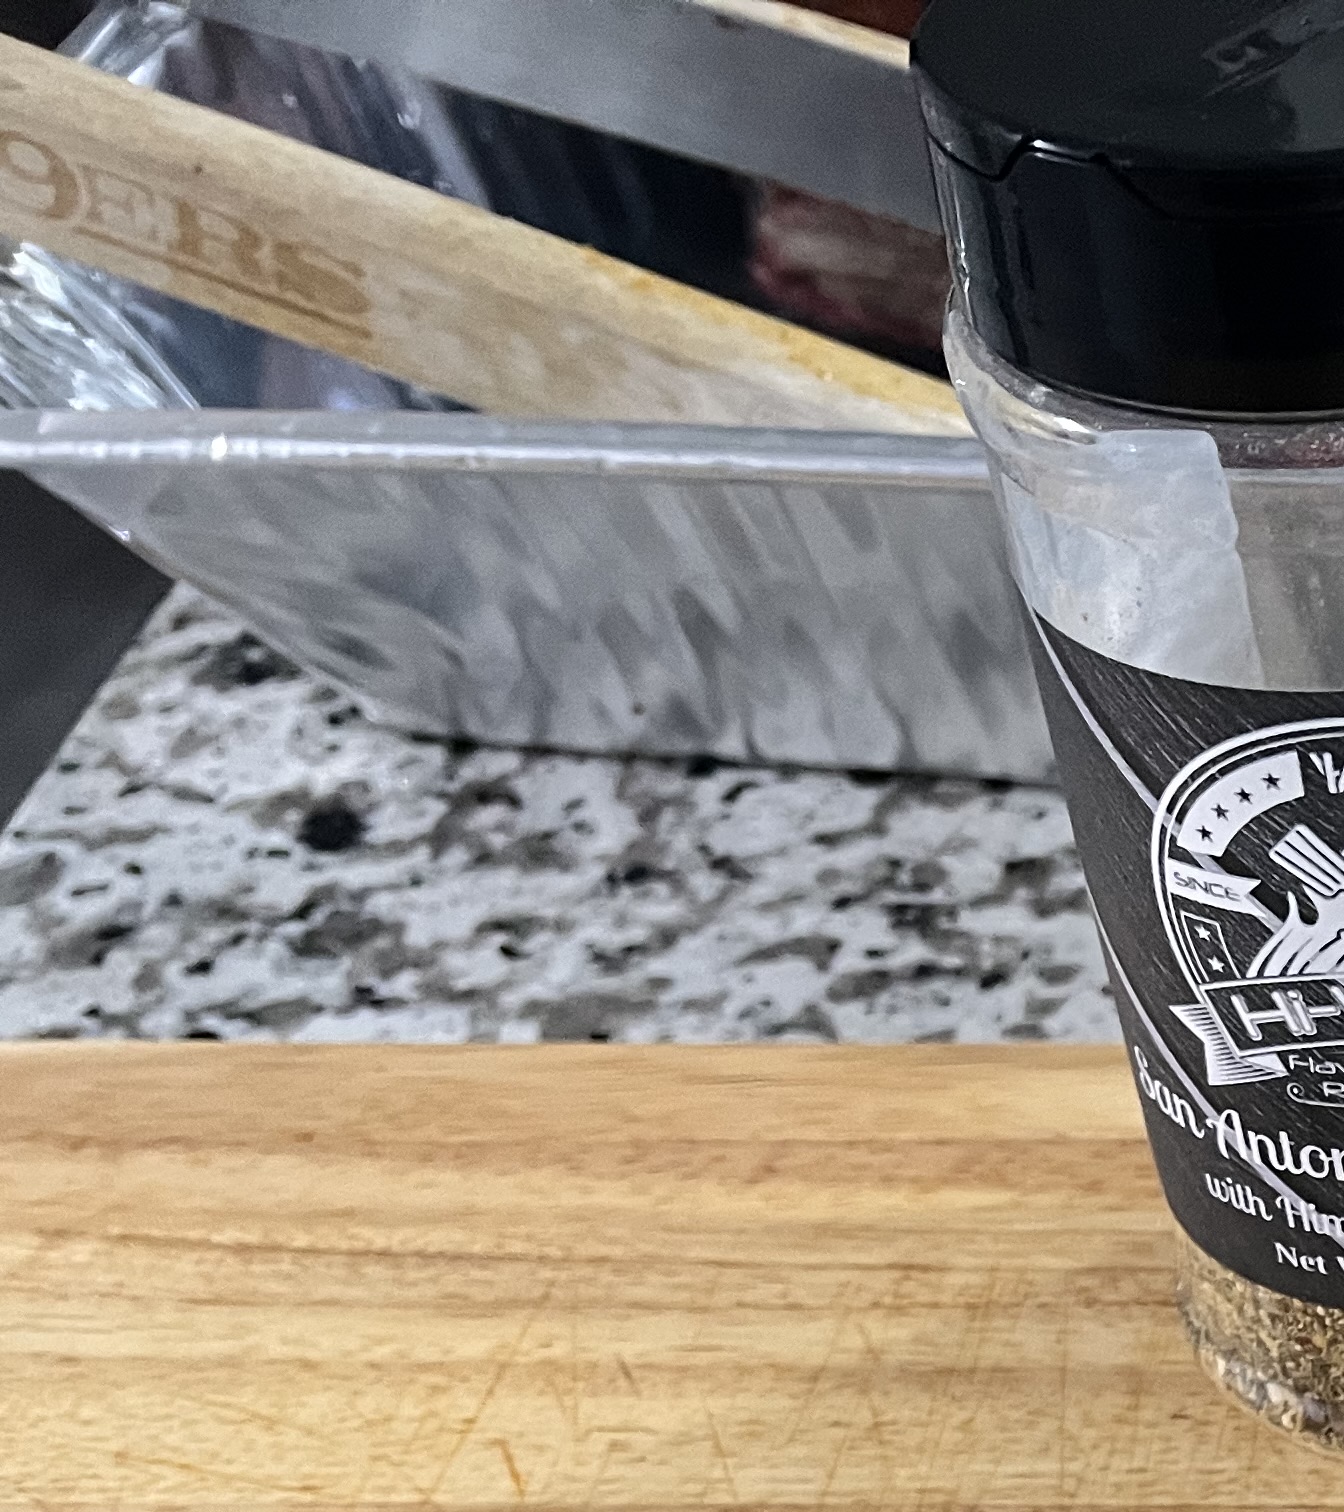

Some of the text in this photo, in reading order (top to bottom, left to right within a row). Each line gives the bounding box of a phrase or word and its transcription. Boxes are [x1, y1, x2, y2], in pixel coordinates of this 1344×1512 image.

[1173, 871, 1241, 902] SINCE
[1133, 1045, 1205, 1140] San
[1204, 1172, 1274, 1222] with
[1273, 1241, 1329, 1276] Net
